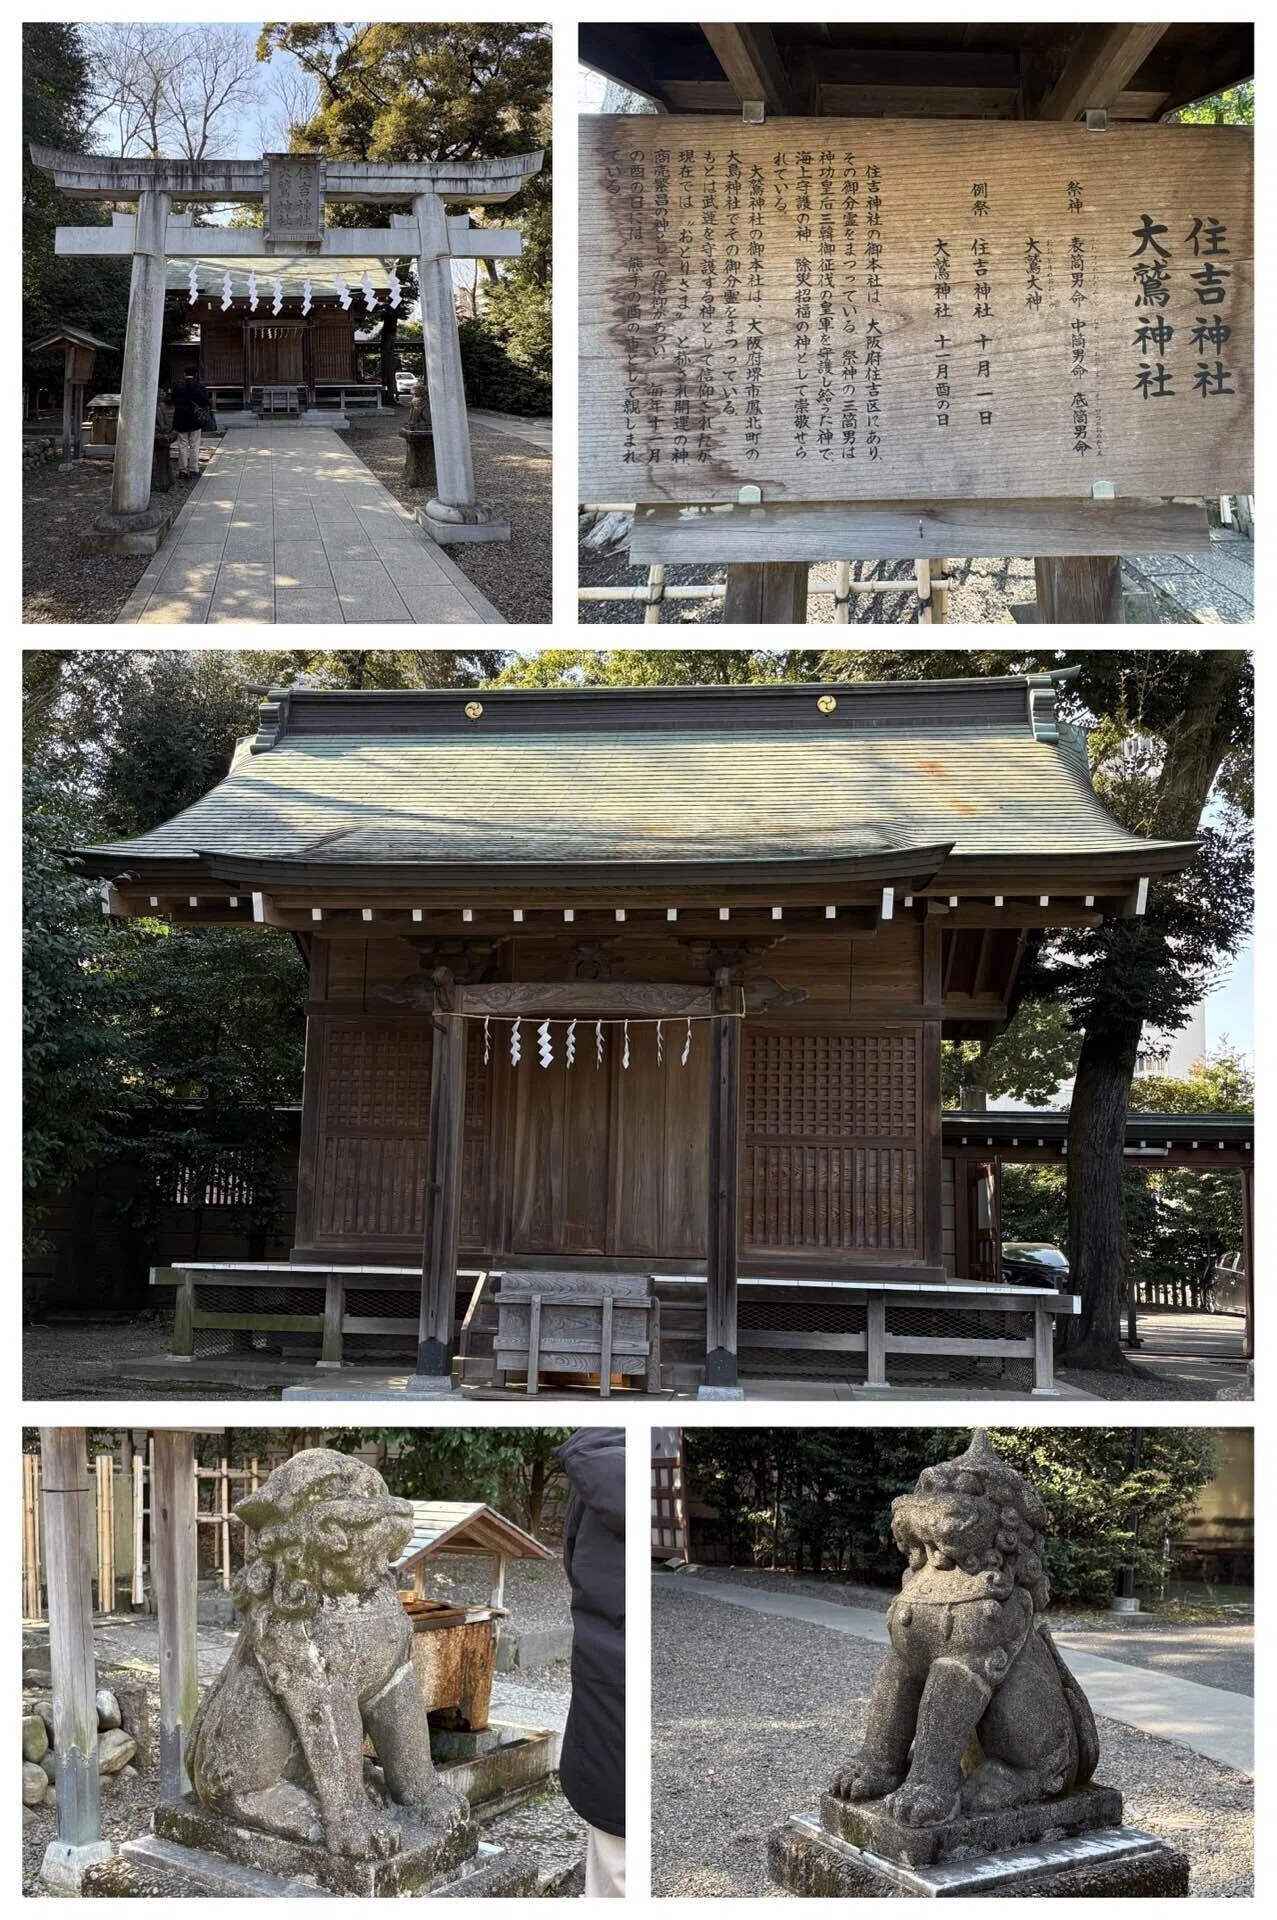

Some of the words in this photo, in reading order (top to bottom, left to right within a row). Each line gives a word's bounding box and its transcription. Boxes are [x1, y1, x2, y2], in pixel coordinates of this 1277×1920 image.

[970, 182, 991, 217] 例祭
[1065, 180, 1084, 214] 祭神
[933, 238, 953, 318] 大鷲神社
[971, 237, 994, 319] 住吉神社
[1024, 236, 1043, 312] 大鷲大神
[1068, 236, 1088, 308] 表筒男命
[1128, 213, 1176, 400] 大鷲神社
[1184, 216, 1235, 398] 住吉神社
[934, 334, 951, 426] 十一月酉の日
[975, 333, 993, 425] 十月一日
[1070, 318, 1088, 380] 中筒男命
[1070, 392, 1092, 457] 底筒男命
